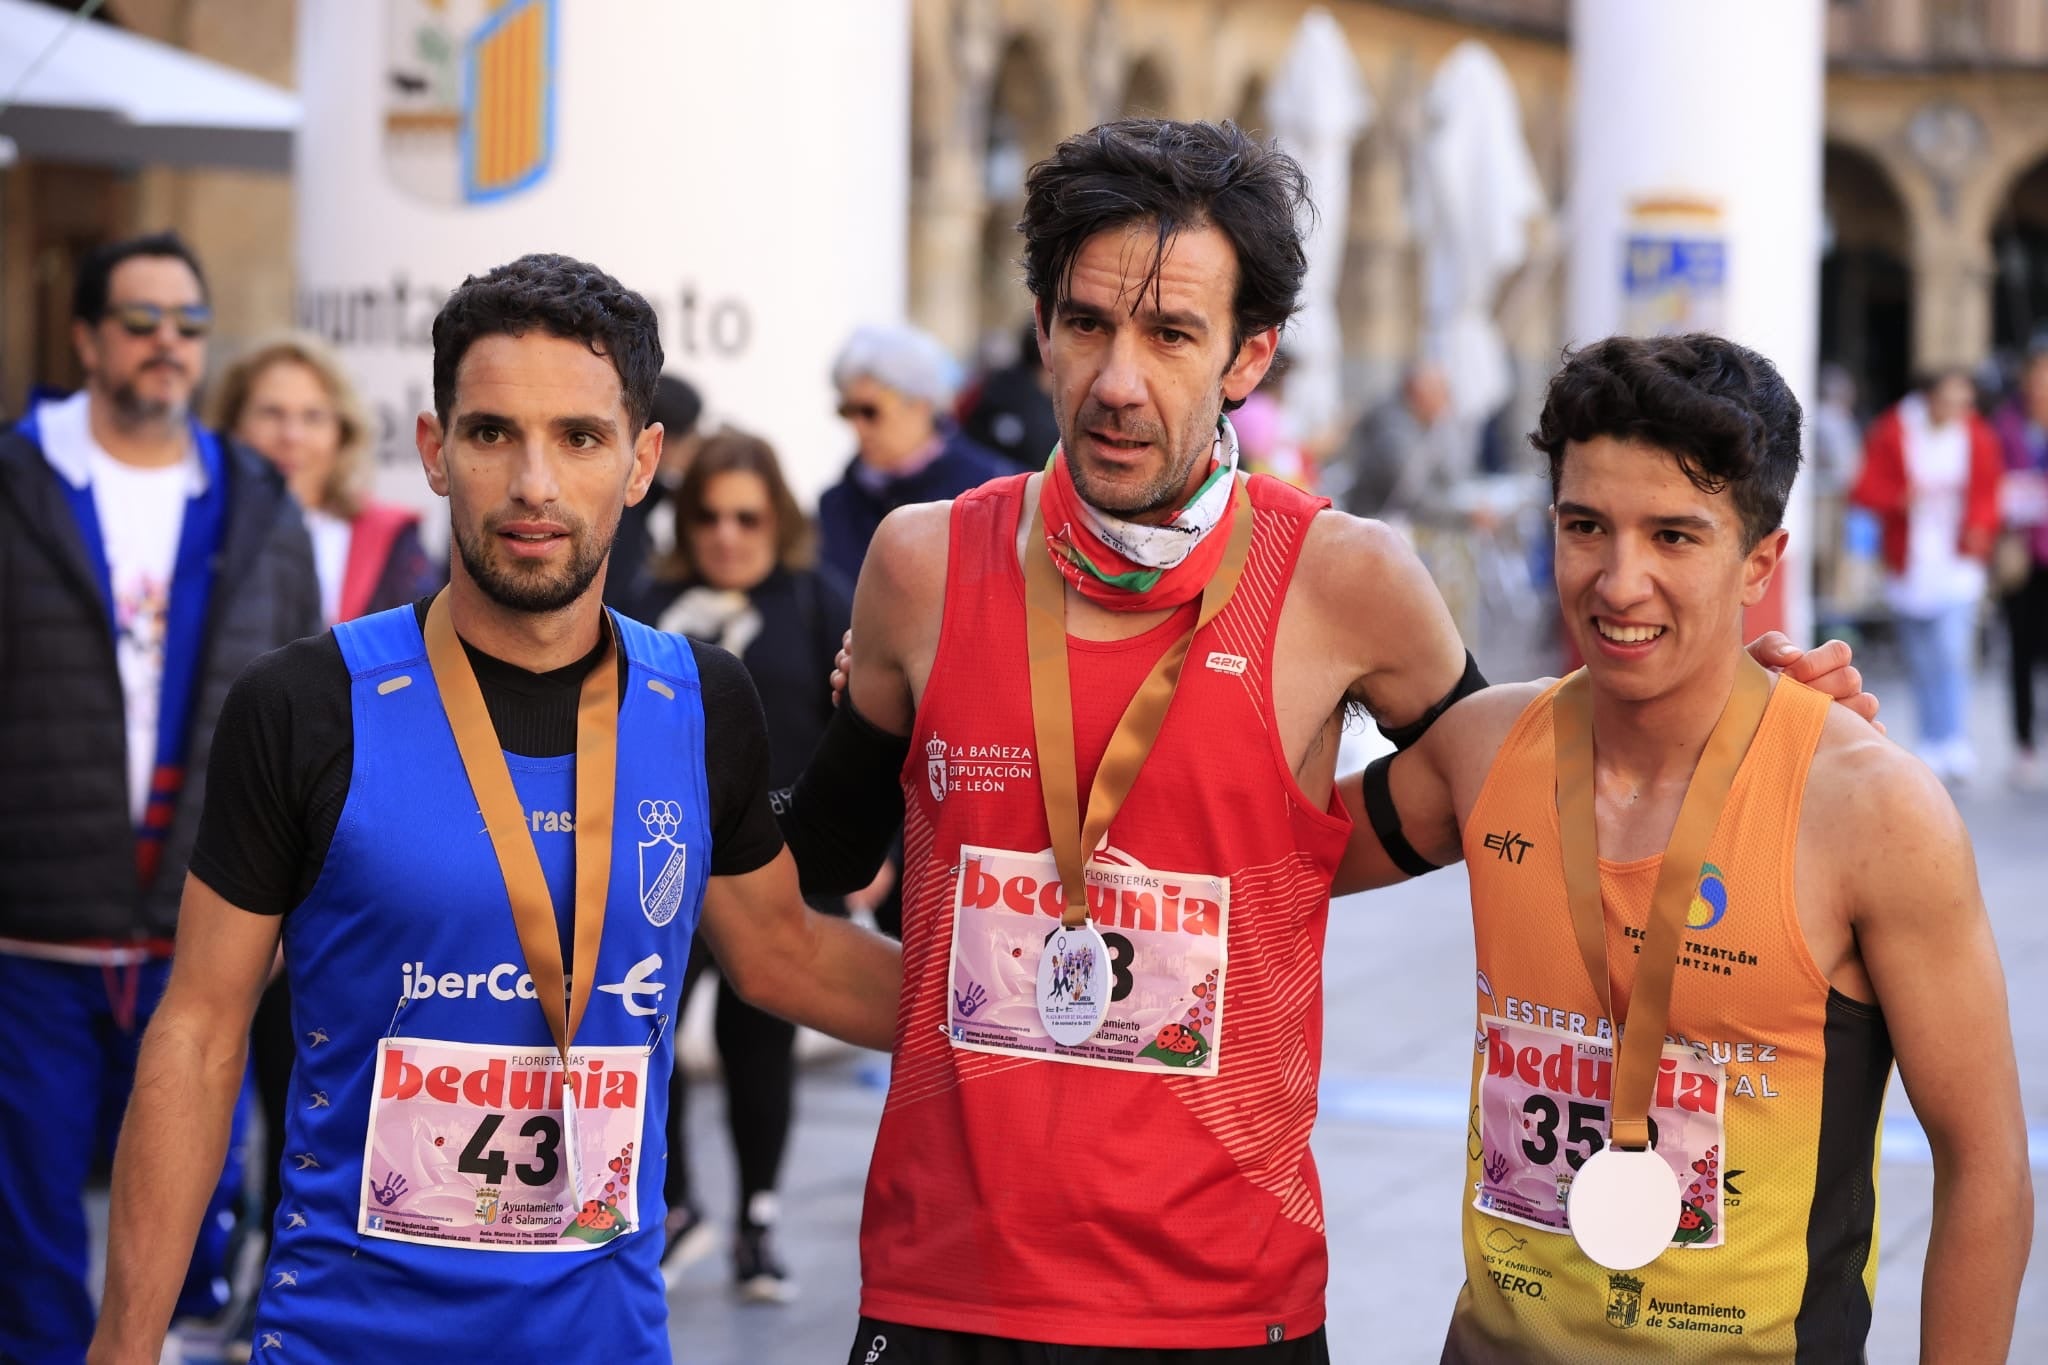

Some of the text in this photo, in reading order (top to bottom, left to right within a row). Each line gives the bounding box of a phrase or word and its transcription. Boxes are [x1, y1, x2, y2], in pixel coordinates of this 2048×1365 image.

[1210, 656, 1243, 670] 42K
[950, 744, 1032, 759] LA BAÑEZA
[949, 765, 1032, 778] DIPUTACIÓN
[949, 779, 1005, 792] DE LEÓN
[532, 810, 576, 832] ras
[1085, 869, 1160, 888] FLORISTERÍAS
[1685, 941, 1758, 966] TRIATLÓN
[401, 961, 572, 1001] iberCa
[1101, 1019, 1140, 1031] amiento
[1505, 996, 1587, 1037] ESTER
[1095, 1030, 1139, 1044] alamanca
[381, 1050, 638, 1110] bedunia
[1488, 1027, 1718, 1114] beduia
[457, 1114, 561, 1187] 43
[502, 1202, 564, 1214] Ayuntamiento
[501, 1214, 562, 1225] de Salamanca
[1505, 1261, 1553, 1278] EMBUTIDOS
[1488, 1269, 1543, 1298] RERO
[1648, 1297, 1746, 1320] Ayuntamiento
[1646, 1315, 1743, 1335] de Salamanca
[864, 1335, 887, 1365] Ca
